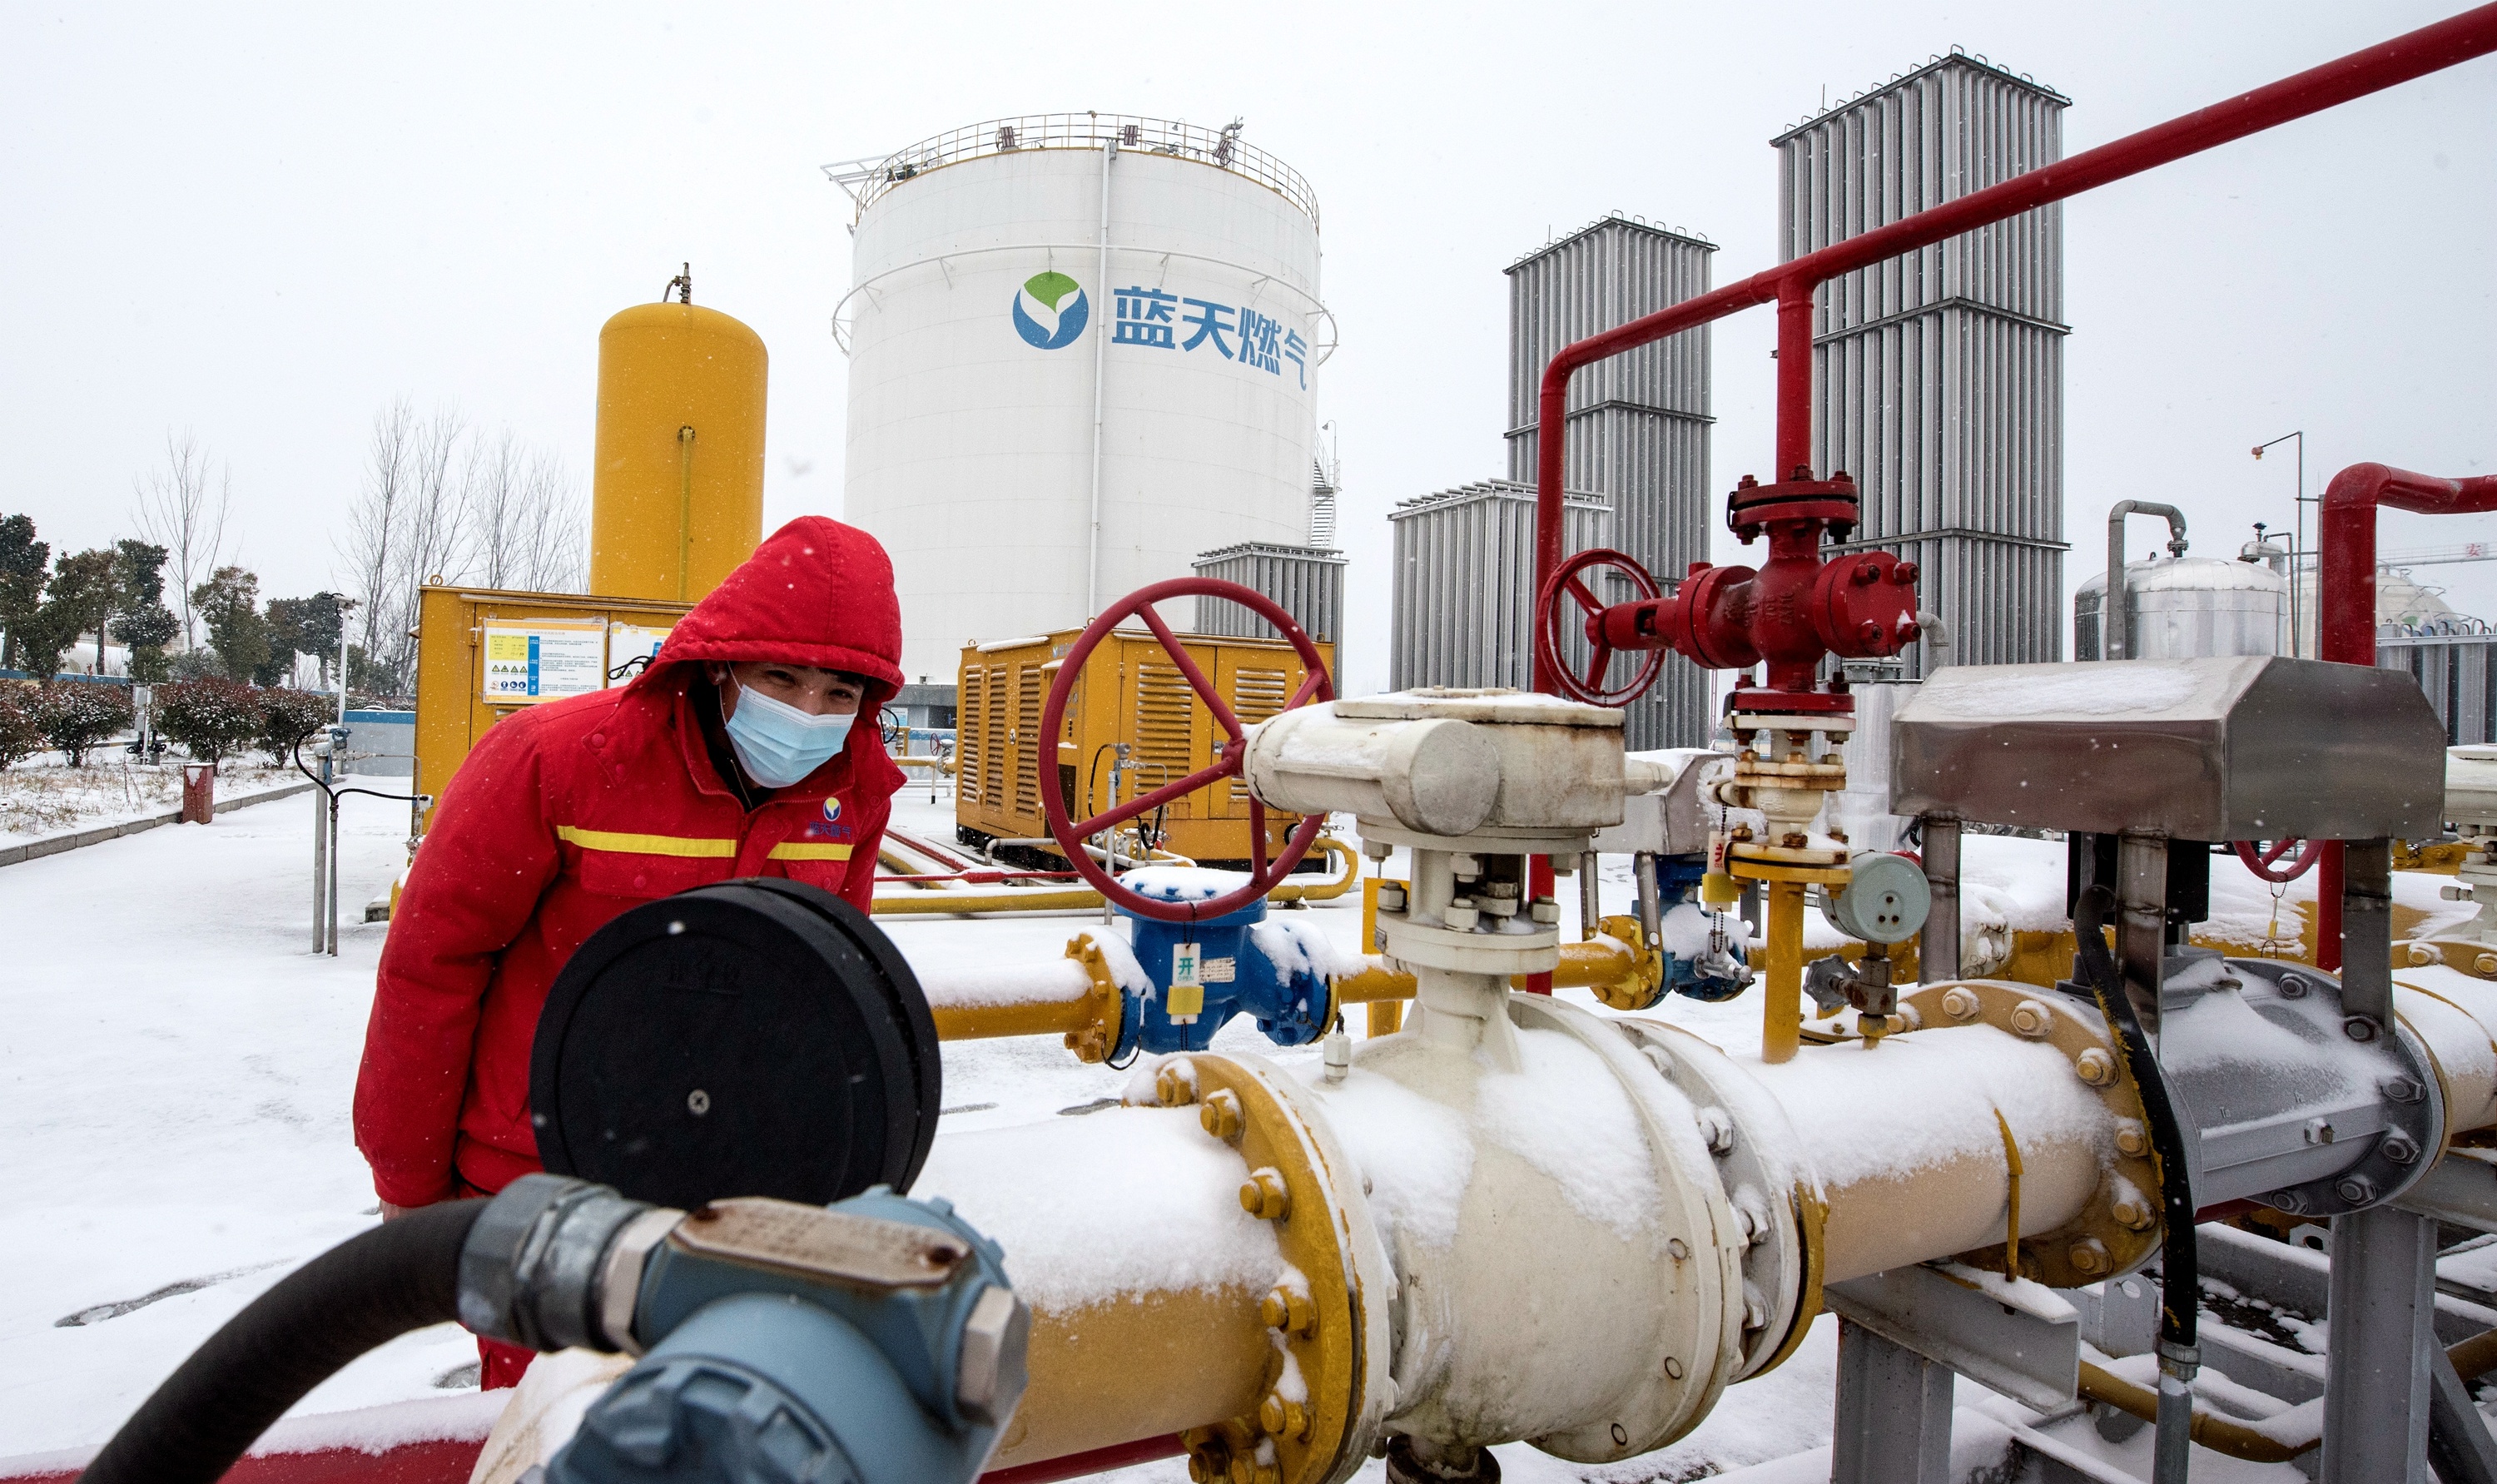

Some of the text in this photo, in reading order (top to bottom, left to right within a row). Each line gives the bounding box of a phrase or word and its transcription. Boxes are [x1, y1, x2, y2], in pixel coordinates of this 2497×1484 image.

[1112, 285, 1308, 391] 蓝天燃气
[1178, 957, 1194, 975] 开
